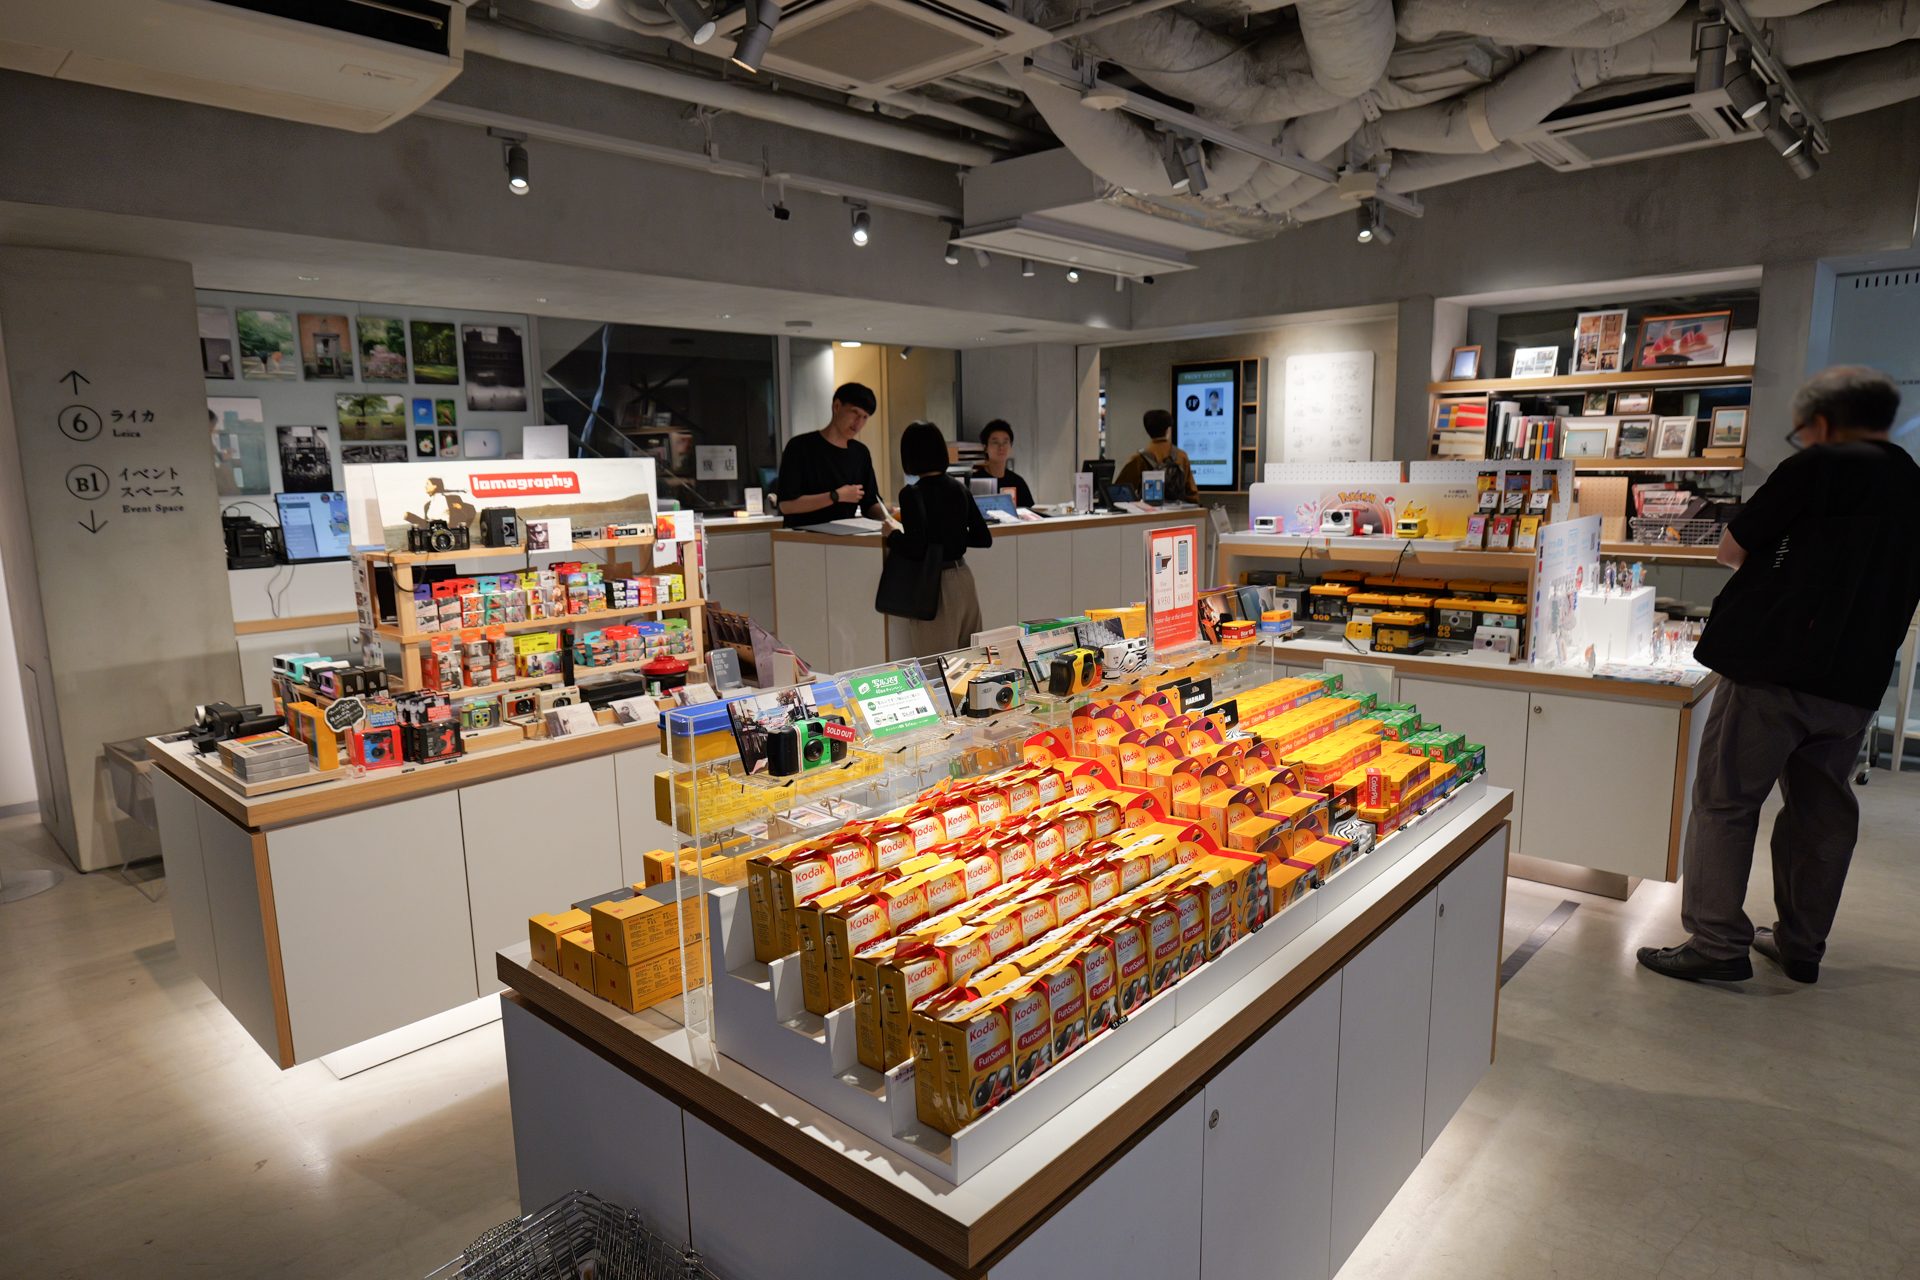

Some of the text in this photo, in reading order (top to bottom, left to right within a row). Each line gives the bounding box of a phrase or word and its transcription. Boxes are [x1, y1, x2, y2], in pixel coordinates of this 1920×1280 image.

[72, 412, 88, 433] 6
[110, 409, 155, 423] ライカ
[112, 428, 141, 438] Leica
[75, 472, 100, 492] B1
[119, 467, 179, 481] イベント
[121, 486, 184, 497] スペース
[122, 504, 184, 514] Event Space
[1185, 692, 1206, 706] HARMAN
[1143, 710, 1159, 723] Kodak
[826, 727, 853, 739] SOLD OUT
[1097, 727, 1116, 738] Kodak
[1191, 737, 1207, 749] Kodak
[1123, 749, 1141, 763] Kodak
[1148, 753, 1166, 766] Kodak
[1411, 749, 1422, 757] 100
[1430, 749, 1441, 757] 100
[1245, 764, 1261, 777] Kodak
[1324, 771, 1342, 782] ColorPlus
[1040, 777, 1060, 792] Kodak
[1075, 782, 1096, 797] Kodak
[1174, 780, 1192, 795] Kodak
[1202, 784, 1219, 798] Kodak
[1371, 776, 1379, 806] ColorPlus
[1012, 787, 1034, 803] Kodak
[1270, 789, 1287, 804] Kodak
[980, 799, 1003, 814] Kodak
[1334, 803, 1353, 820] HARMAN
[948, 812, 971, 827] Kodak
[1097, 809, 1117, 825] Kodak
[1127, 815, 1146, 829] Kodak
[1229, 809, 1247, 825] Kodak
[914, 822, 938, 838] Kodak
[1066, 821, 1087, 836] Kodak
[881, 838, 908, 856] Kodak
[1036, 834, 1058, 850] Kodak
[1295, 835, 1311, 849] Kodak
[836, 848, 865, 867] Kodak
[1003, 848, 1027, 865] Kodak
[1179, 849, 1199, 864] Kodak
[795, 864, 826, 884] Kodak
[967, 863, 992, 880] Kodak
[930, 880, 957, 898] Kodak
[1211, 886, 1228, 902] Kodak
[891, 892, 919, 912] Kodak
[1058, 889, 1082, 906] Kodak
[1023, 906, 1048, 925] Kodak
[1179, 900, 1199, 917] Kodak
[849, 911, 880, 932] Kodak
[1152, 916, 1174, 935] Kodak
[989, 923, 1014, 943] Kodak
[1184, 922, 1204, 938] FunSaver
[1117, 932, 1139, 952] Kodak
[1157, 940, 1179, 956] FunSaver
[954, 945, 982, 967] Kodak
[1086, 952, 1109, 973] Kodak
[1123, 956, 1146, 976] FunSaver
[907, 963, 938, 986] Kodak
[1050, 974, 1076, 996] Kodak
[1014, 999, 1043, 1022] Kodak
[1057, 999, 1082, 1020] FunSaver
[970, 1016, 1001, 1042] Kodak
[1021, 1023, 1048, 1046] FunSaver
[978, 1045, 1007, 1068] FunSaver
